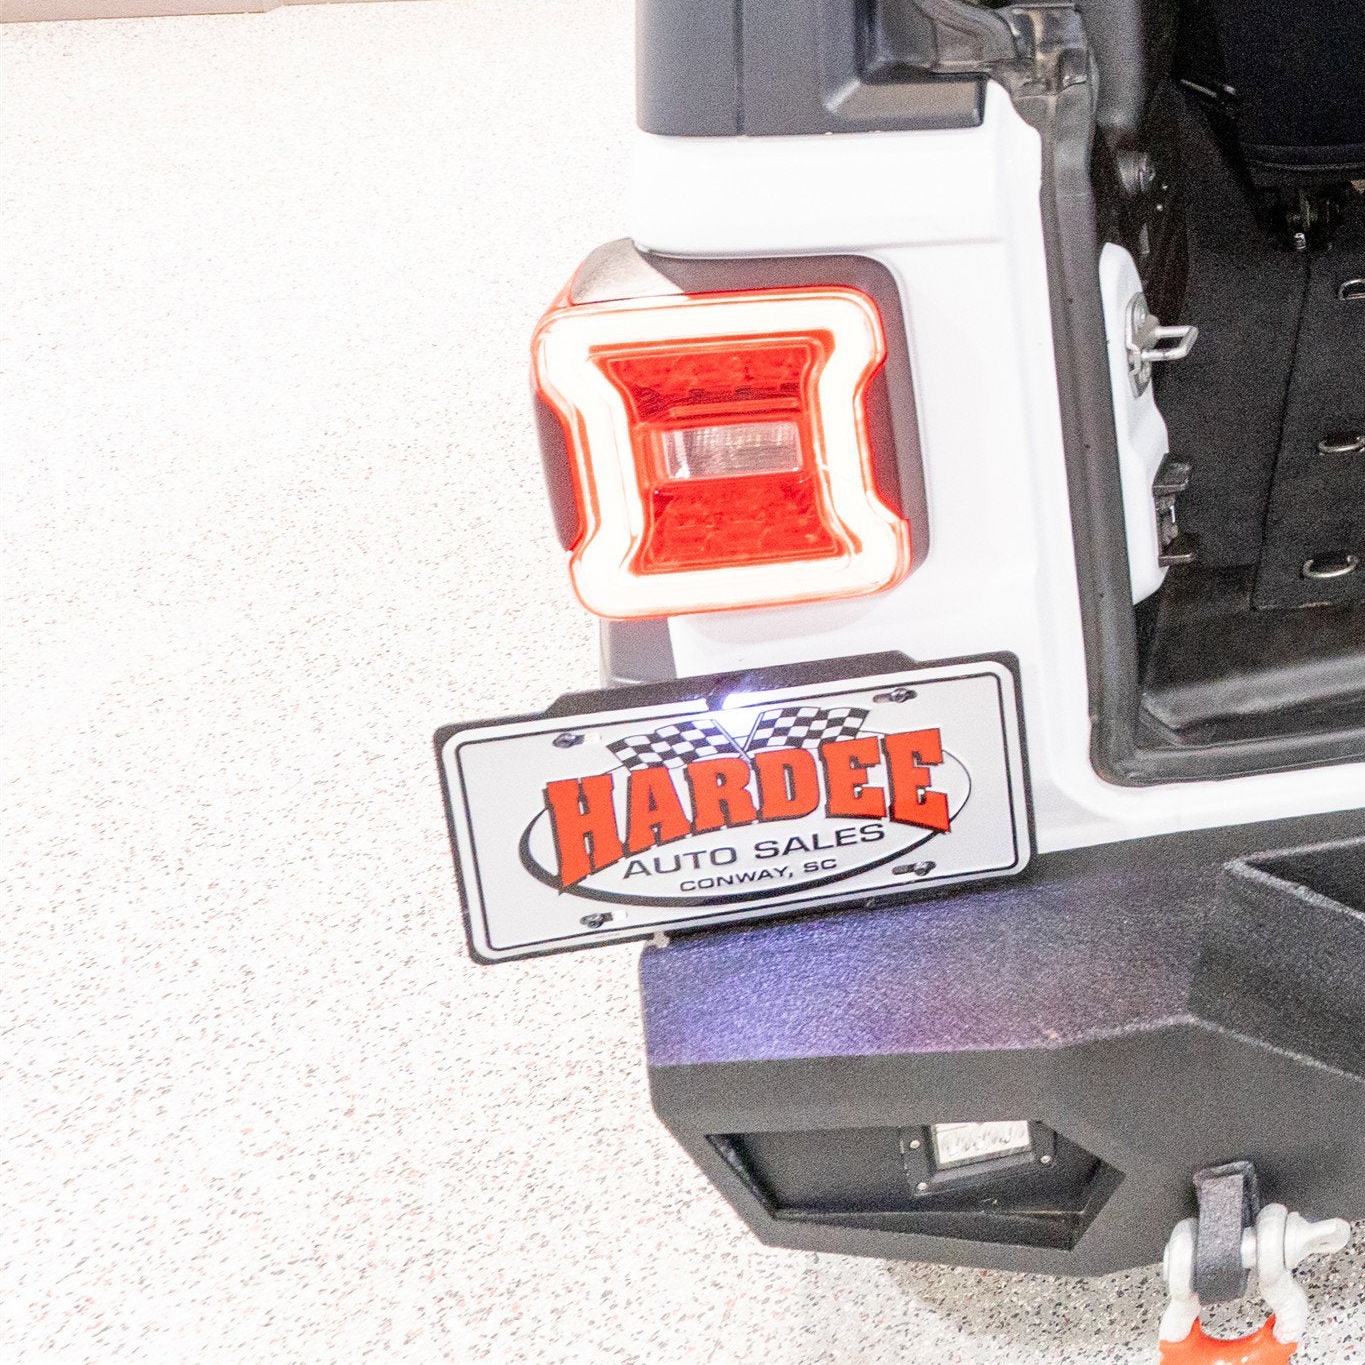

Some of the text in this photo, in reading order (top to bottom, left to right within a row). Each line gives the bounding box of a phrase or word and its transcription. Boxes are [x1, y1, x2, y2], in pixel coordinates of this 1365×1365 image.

[542, 728, 950, 895] HARDEE
[623, 824, 885, 879] AUTO SALES
[680, 859, 837, 892] CONWAY, SC
